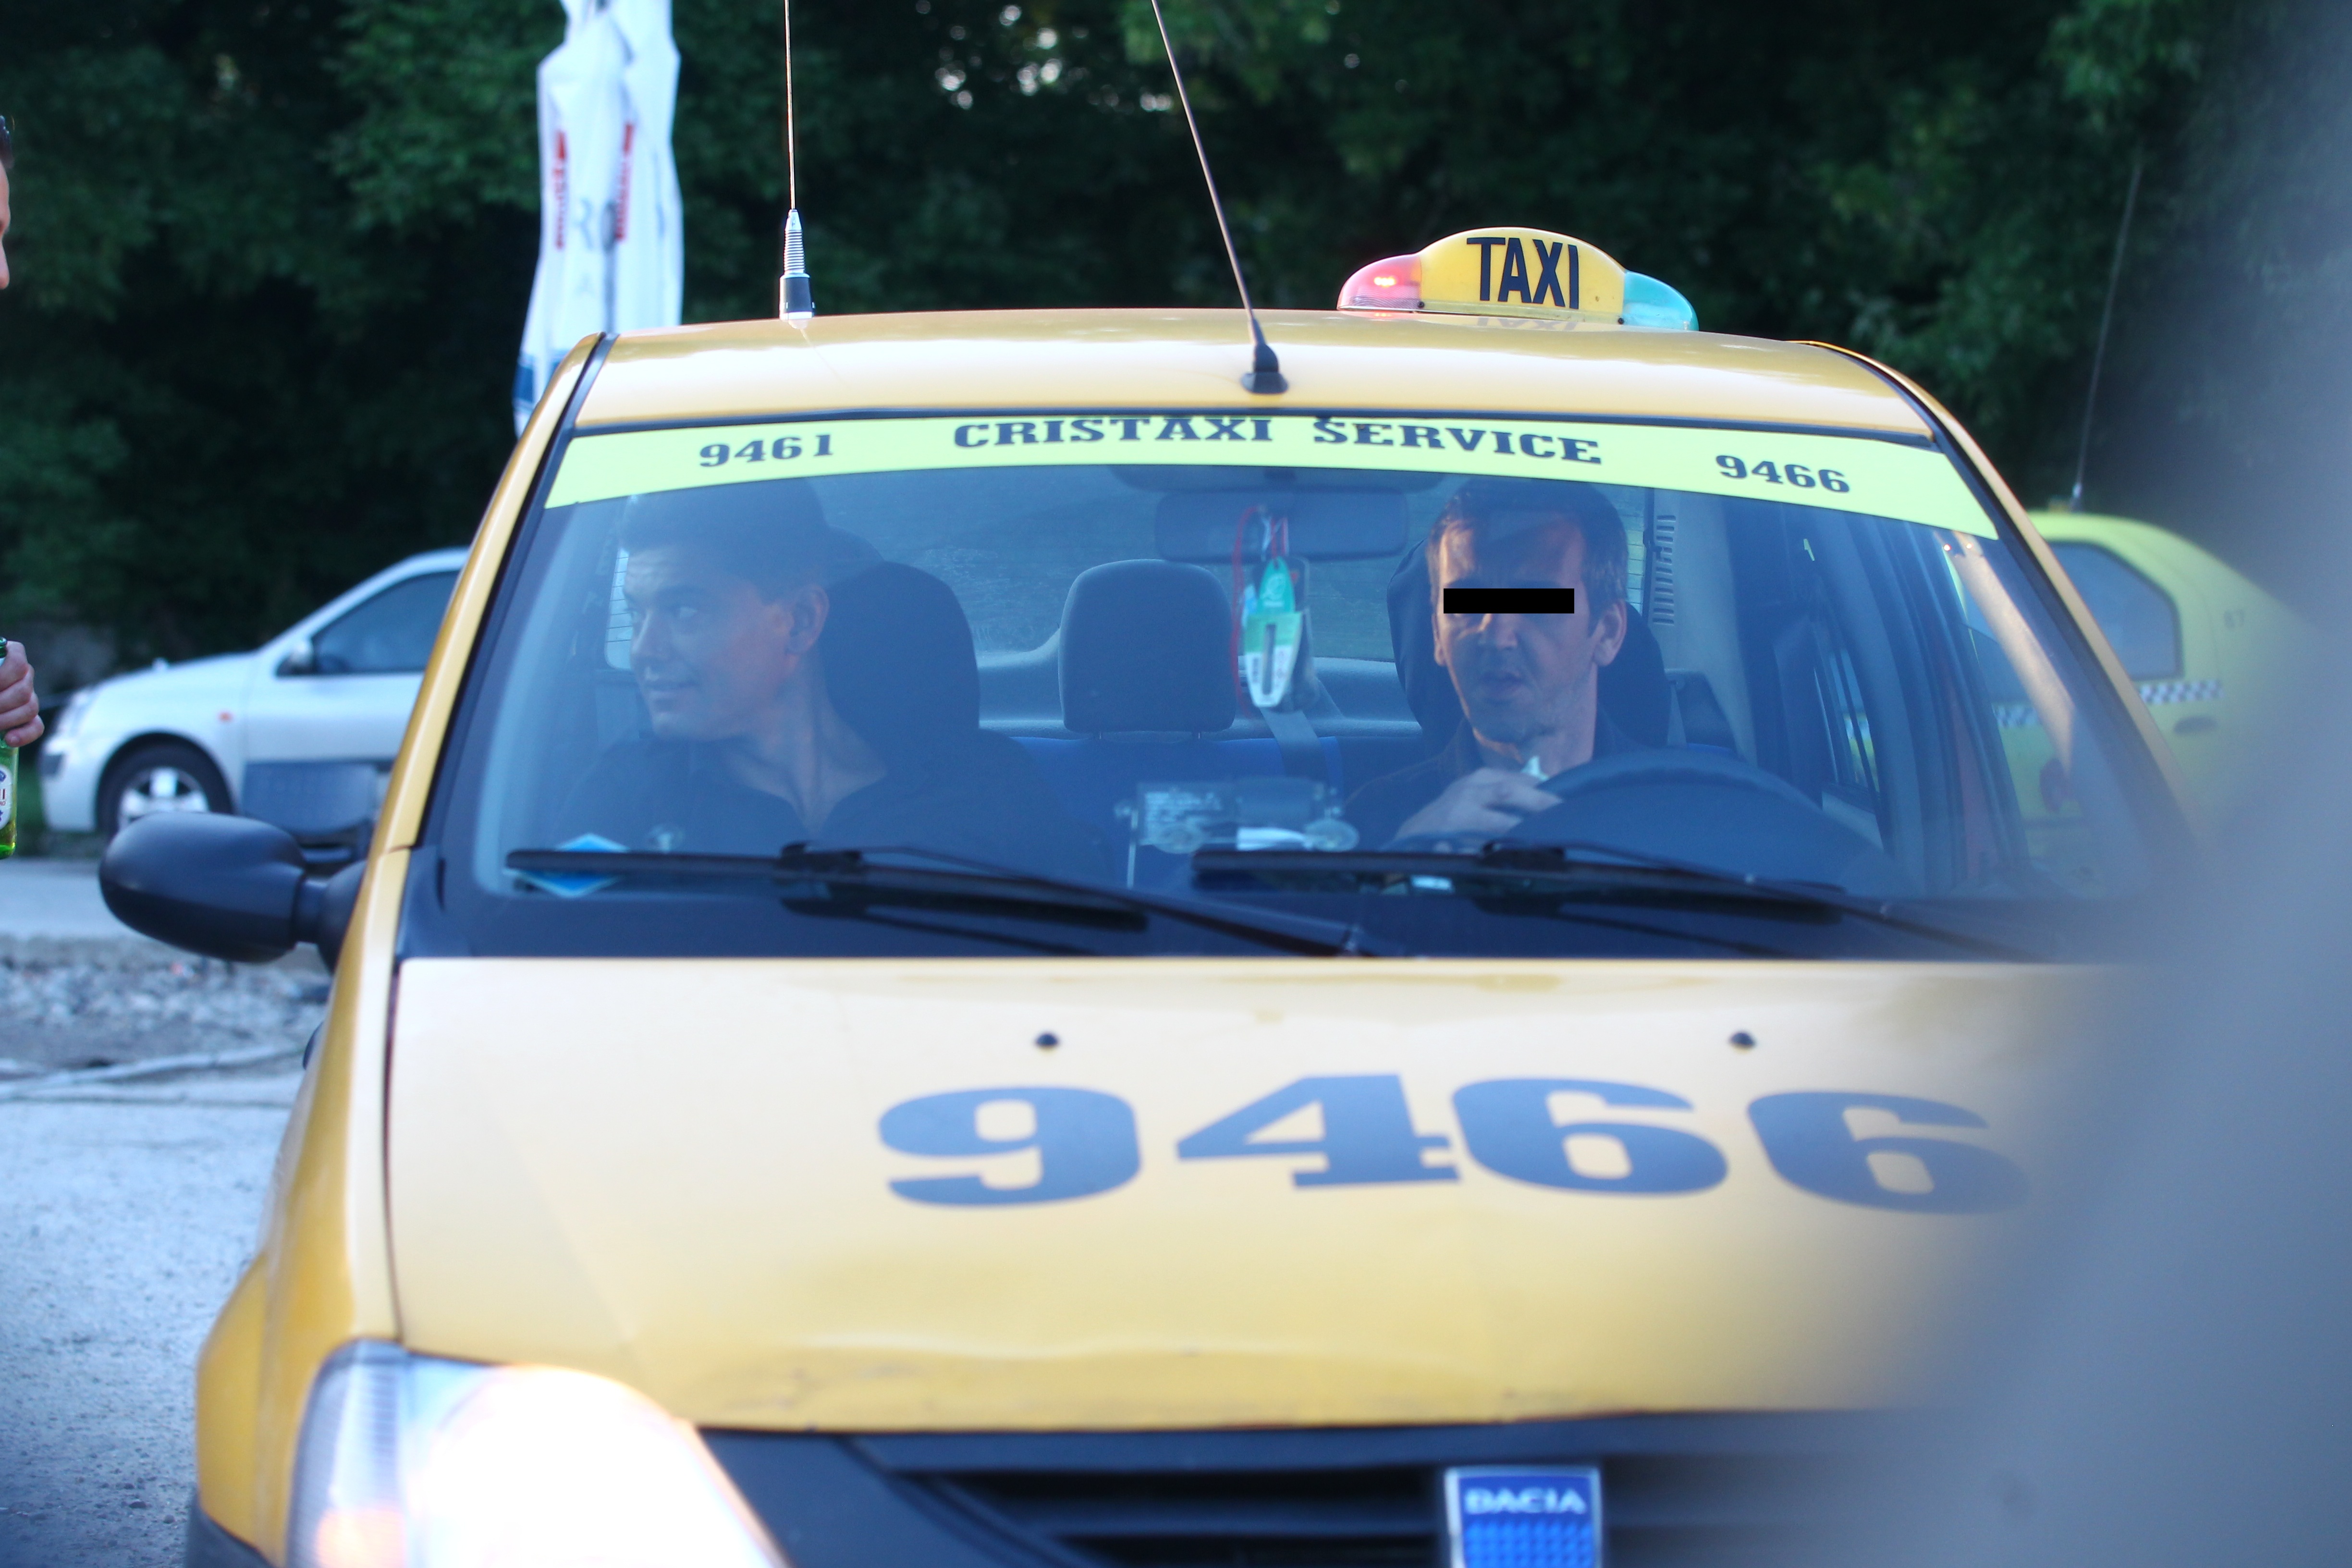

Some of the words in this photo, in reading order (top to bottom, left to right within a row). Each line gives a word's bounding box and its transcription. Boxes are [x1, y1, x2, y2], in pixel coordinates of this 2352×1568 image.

[1467, 237, 1579, 309] TAXI
[699, 434, 833, 467] 9461
[954, 417, 1273, 447] CRISTAXI
[1313, 417, 1602, 464] SERVICE
[1715, 455, 1850, 493] 9466
[878, 1073, 2028, 1214] 9466
[1465, 1488, 1586, 1514] DACIA
